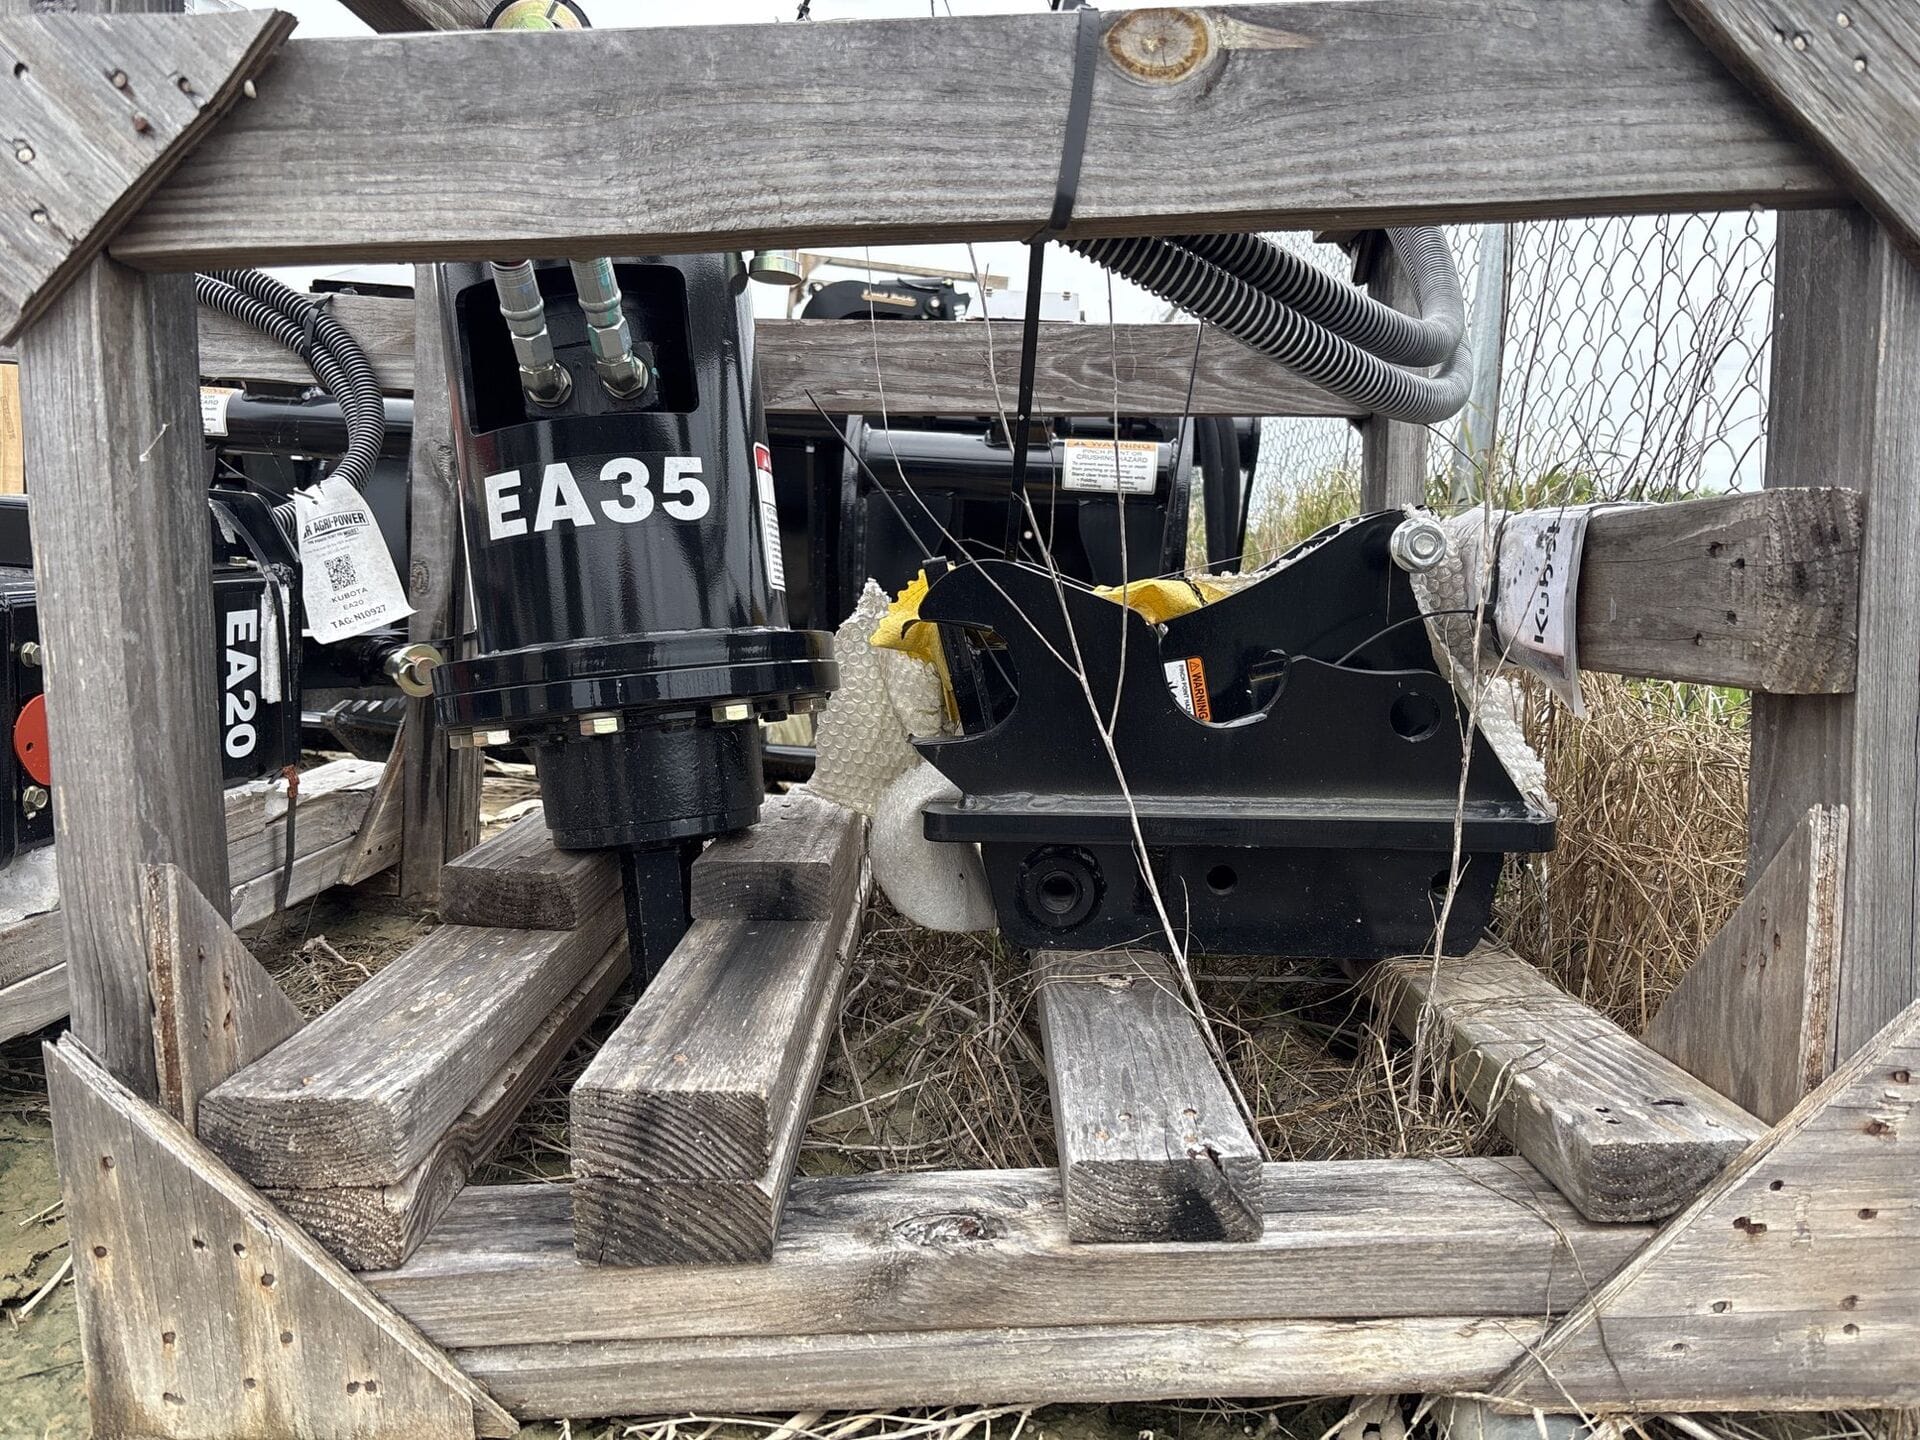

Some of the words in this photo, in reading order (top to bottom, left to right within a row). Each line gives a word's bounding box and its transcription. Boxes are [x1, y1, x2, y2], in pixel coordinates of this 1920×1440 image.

[484, 456, 711, 541] EA35
[314, 512, 366, 532] AGRI-POWER
[331, 587, 369, 603] KUBOTA
[342, 599, 365, 611] EA20
[225, 608, 258, 759] EA20
[1192, 672, 1208, 720] WARNING
